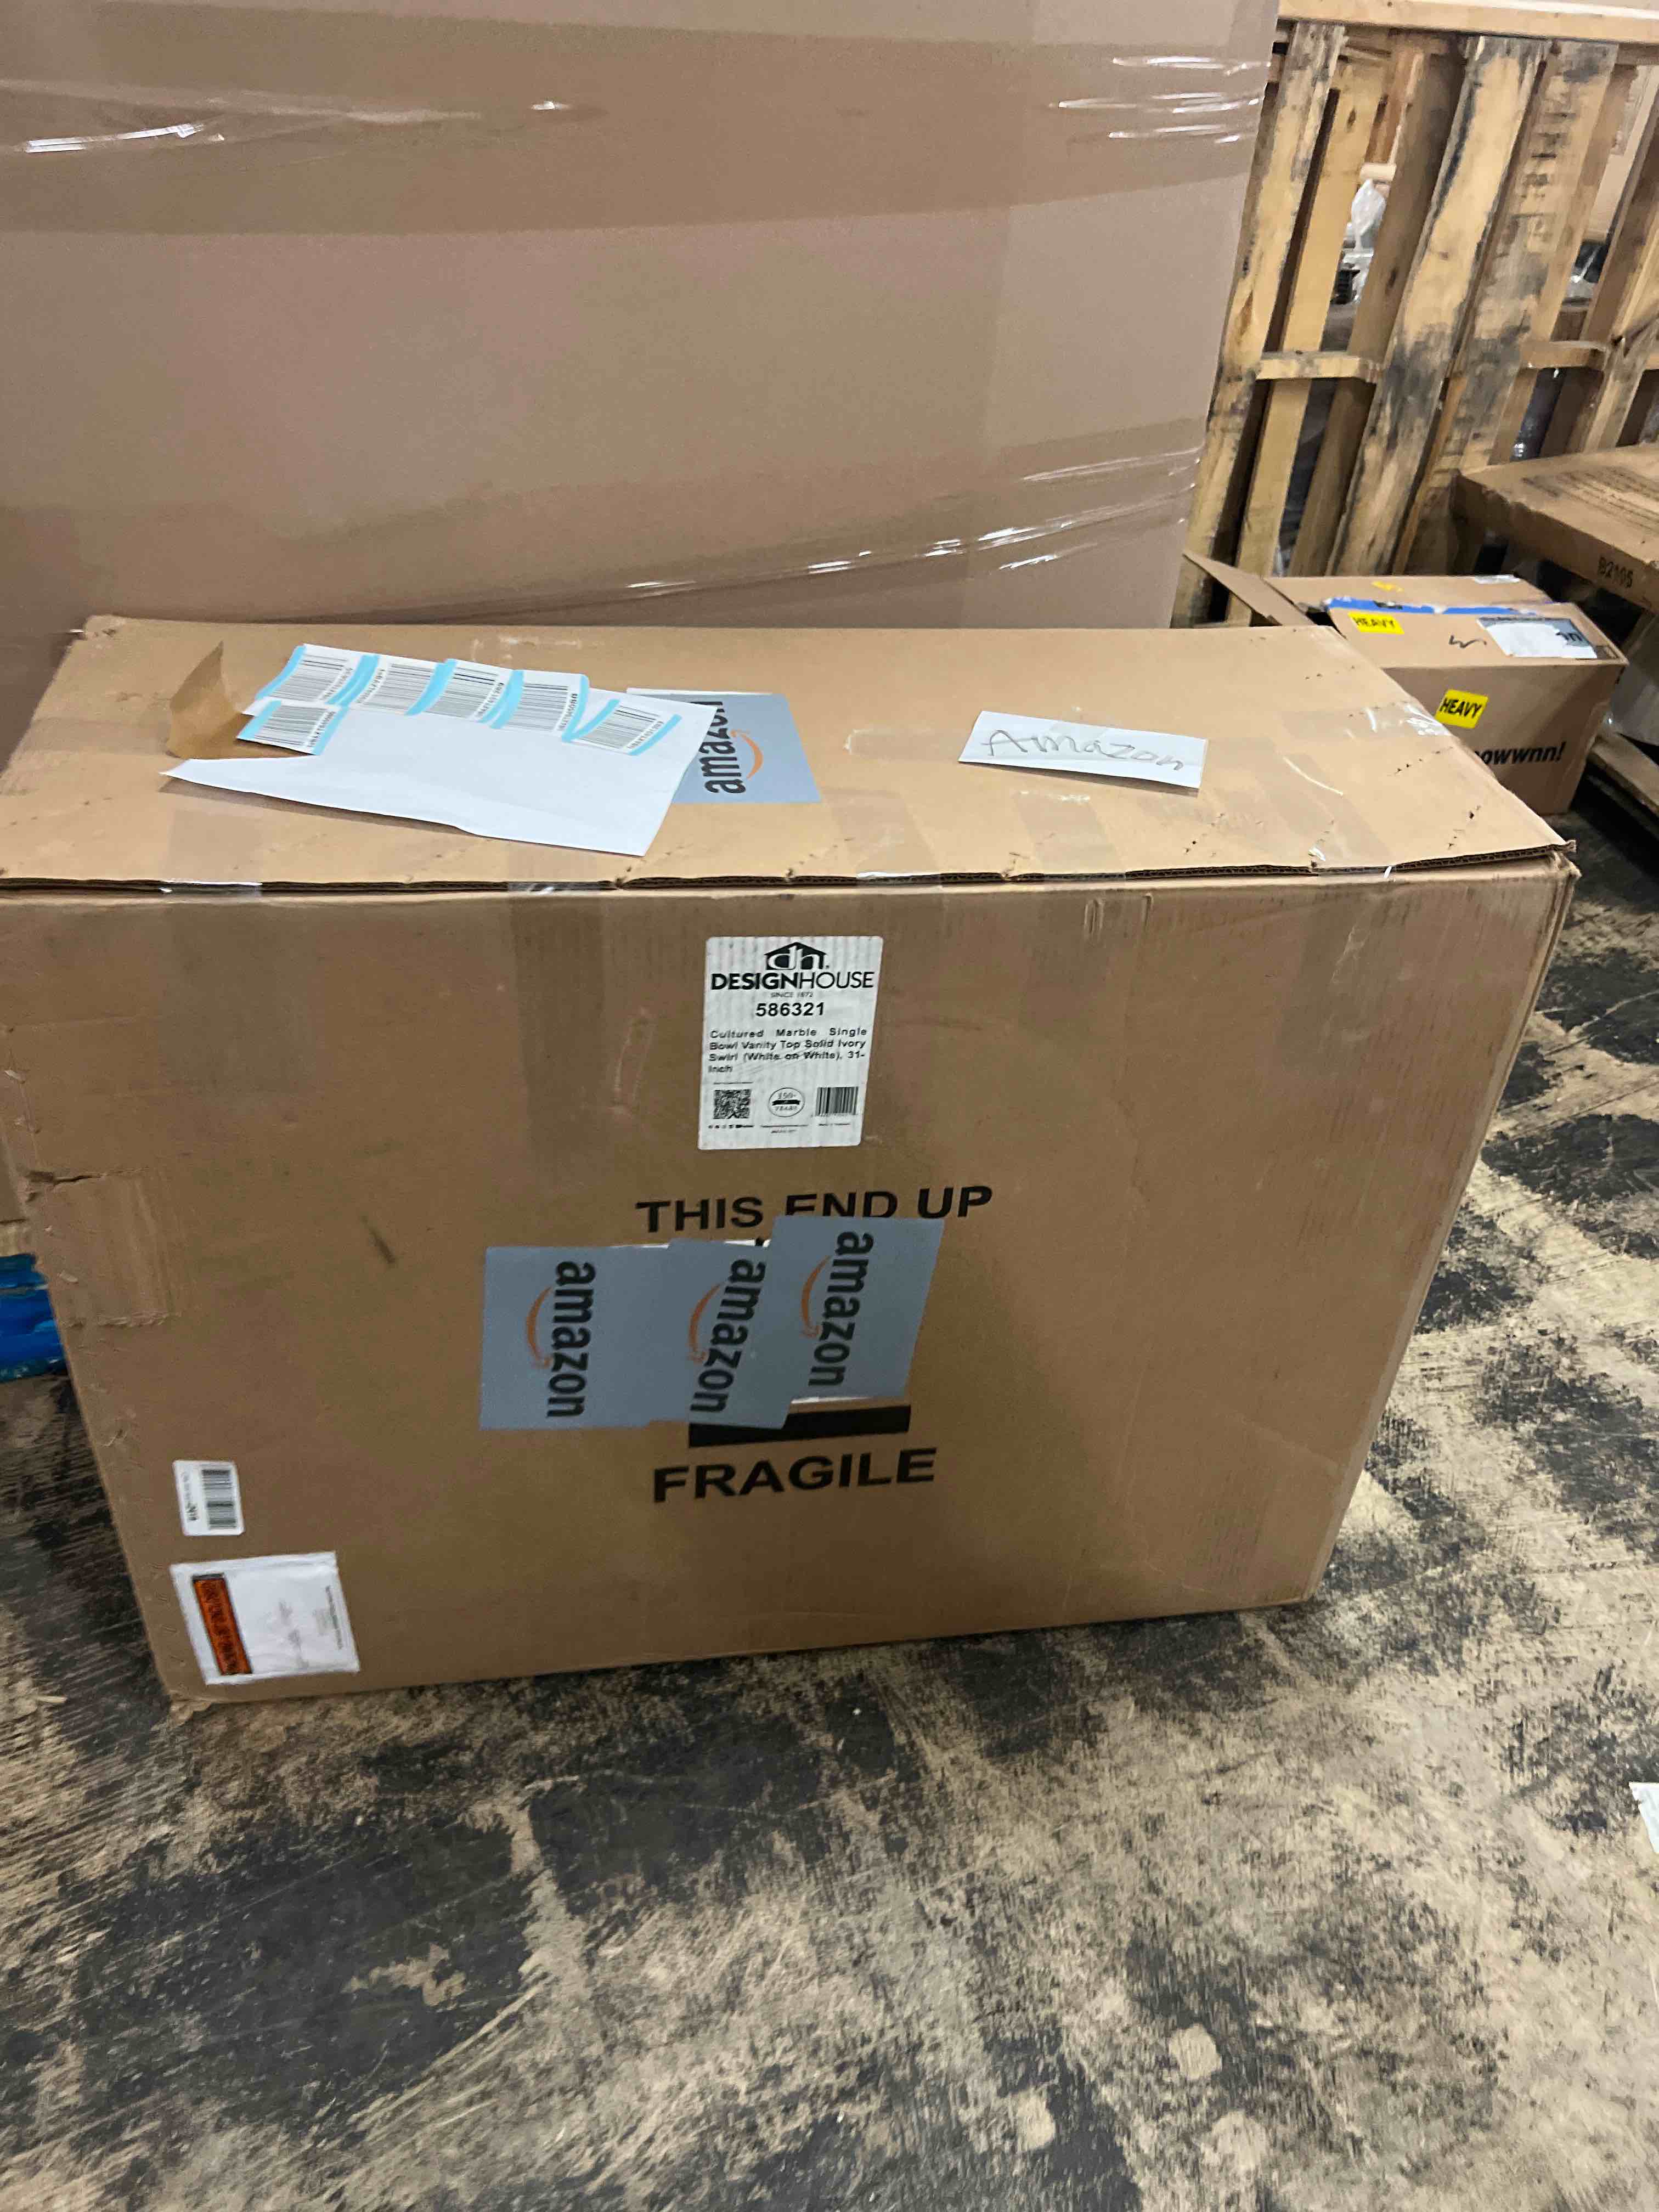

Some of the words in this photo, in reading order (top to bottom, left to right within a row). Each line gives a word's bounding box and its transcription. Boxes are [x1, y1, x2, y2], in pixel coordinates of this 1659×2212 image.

[1439, 698, 1482, 719] HEAVY
[981, 729, 1184, 771] Amazon
[755, 1002, 825, 1017] 586321
[709, 1041, 738, 1050] Bowl
[742, 1041, 777, 1051] Vanity
[780, 1040, 801, 1049] Top
[804, 1039, 834, 1048] Solid
[838, 1039, 866, 1049] Ivory
[710, 1029, 764, 1039] Cultured
[776, 1028, 817, 1037] Marble
[829, 1027, 867, 1037] Single
[709, 1053, 738, 1062] Swirl
[743, 1052, 780, 1062] (White
[847, 1050, 865, 1059] 31-
[635, 1196, 764, 1233] THIS
[917, 1186, 993, 1219] UP
[808, 1231, 874, 1387] amazon
[547, 1261, 596, 1418] amazon
[690, 1259, 766, 1414] amazon
[653, 1447, 938, 1504] FRAGILE
